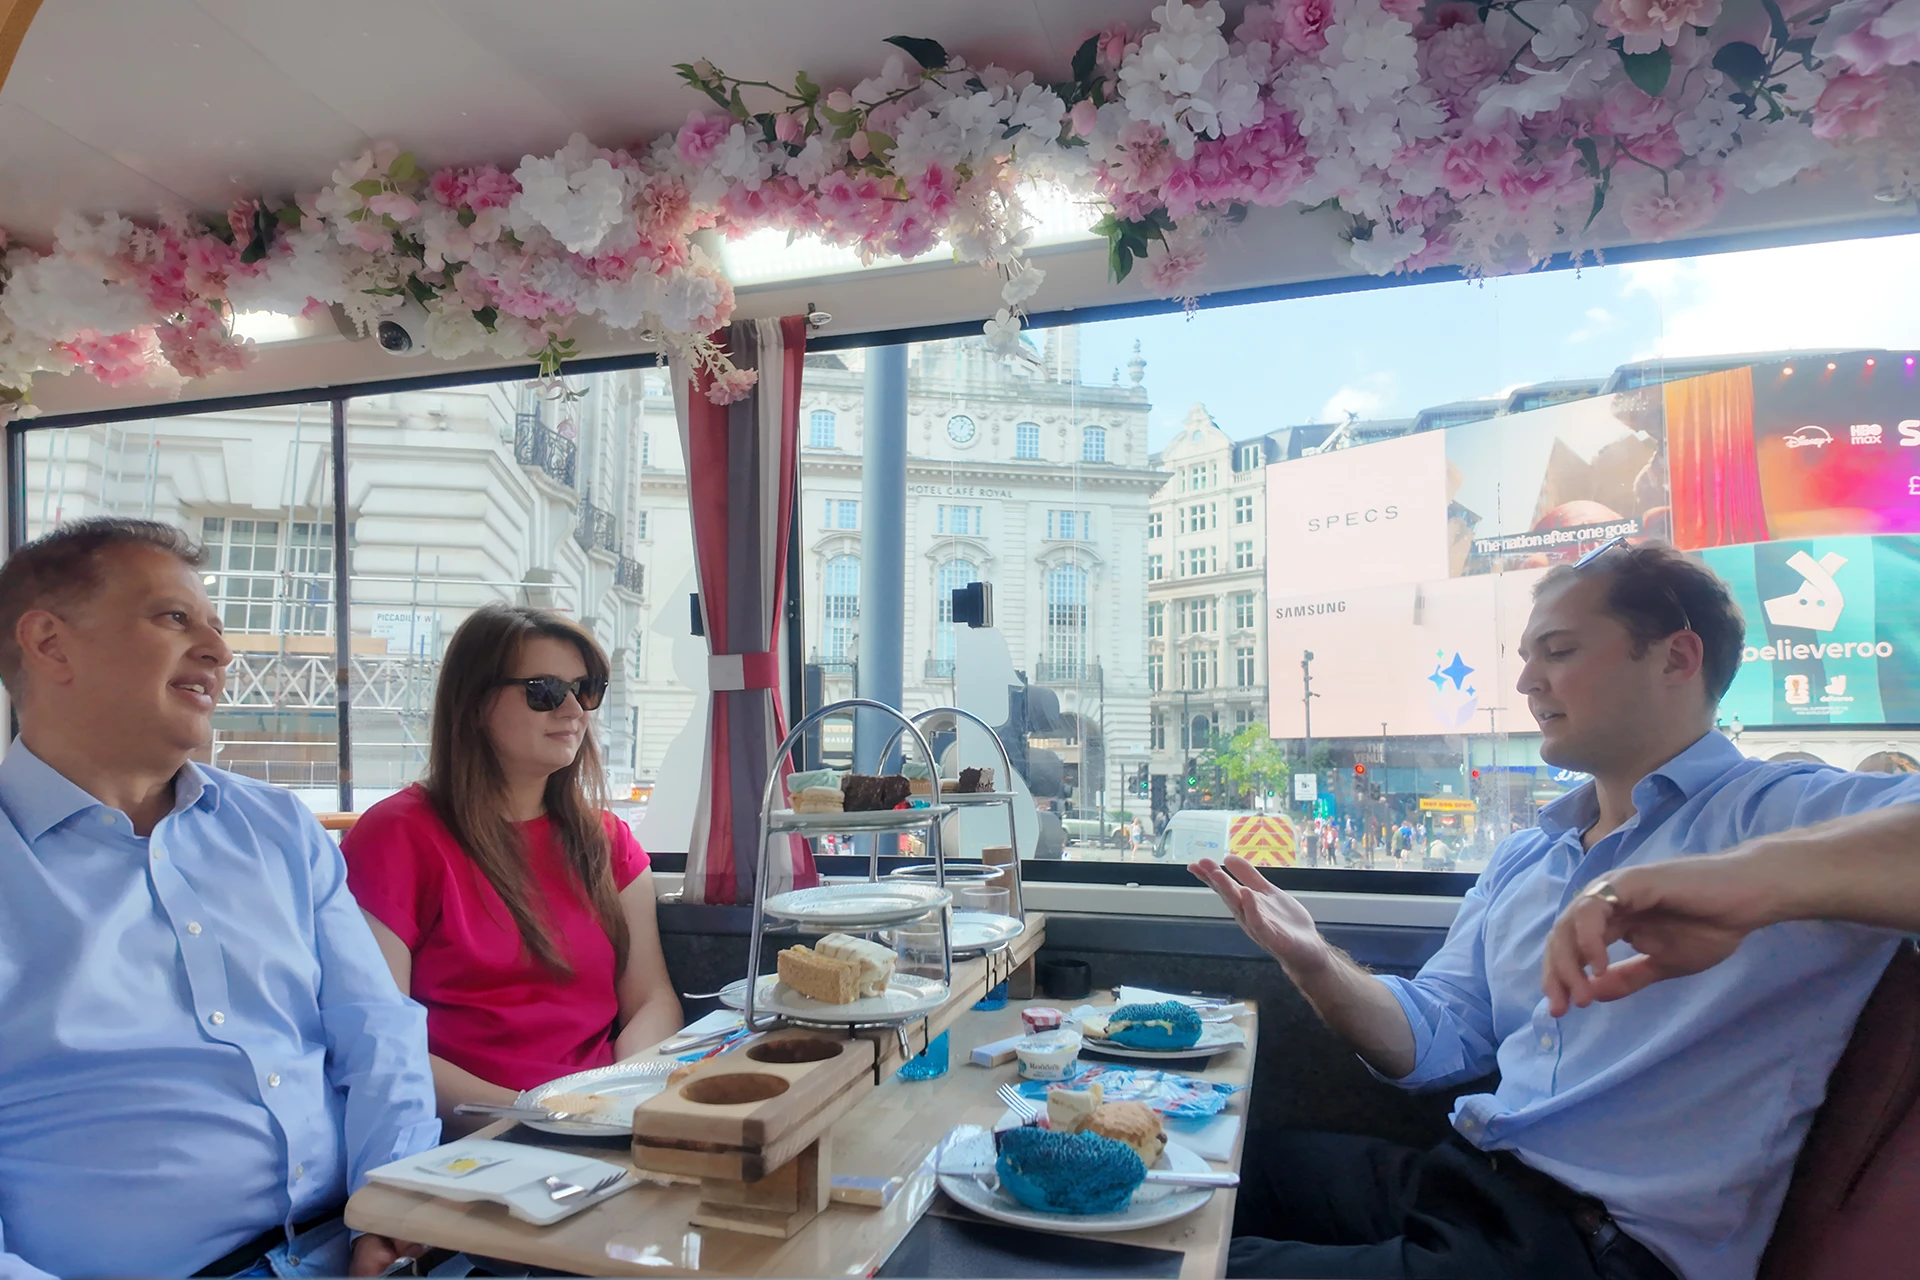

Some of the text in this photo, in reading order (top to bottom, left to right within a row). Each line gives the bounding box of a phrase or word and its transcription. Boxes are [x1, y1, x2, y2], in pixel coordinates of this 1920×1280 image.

[1850, 423, 1882, 436] HBO
[1851, 435, 1882, 445] max
[907, 485, 1013, 498] HOTEL CAFÉ ROYAL
[1308, 505, 1398, 532] SPECS
[1475, 539, 1501, 553] The
[1502, 534, 1543, 550] nation
[1543, 530, 1577, 545] after
[1576, 527, 1604, 540] one
[1276, 600, 1346, 619] SAMSUNG
[377, 613, 421, 622] PICCADILY
[1367, 742, 1385, 753] THE
[1353, 752, 1385, 764] VENUE
